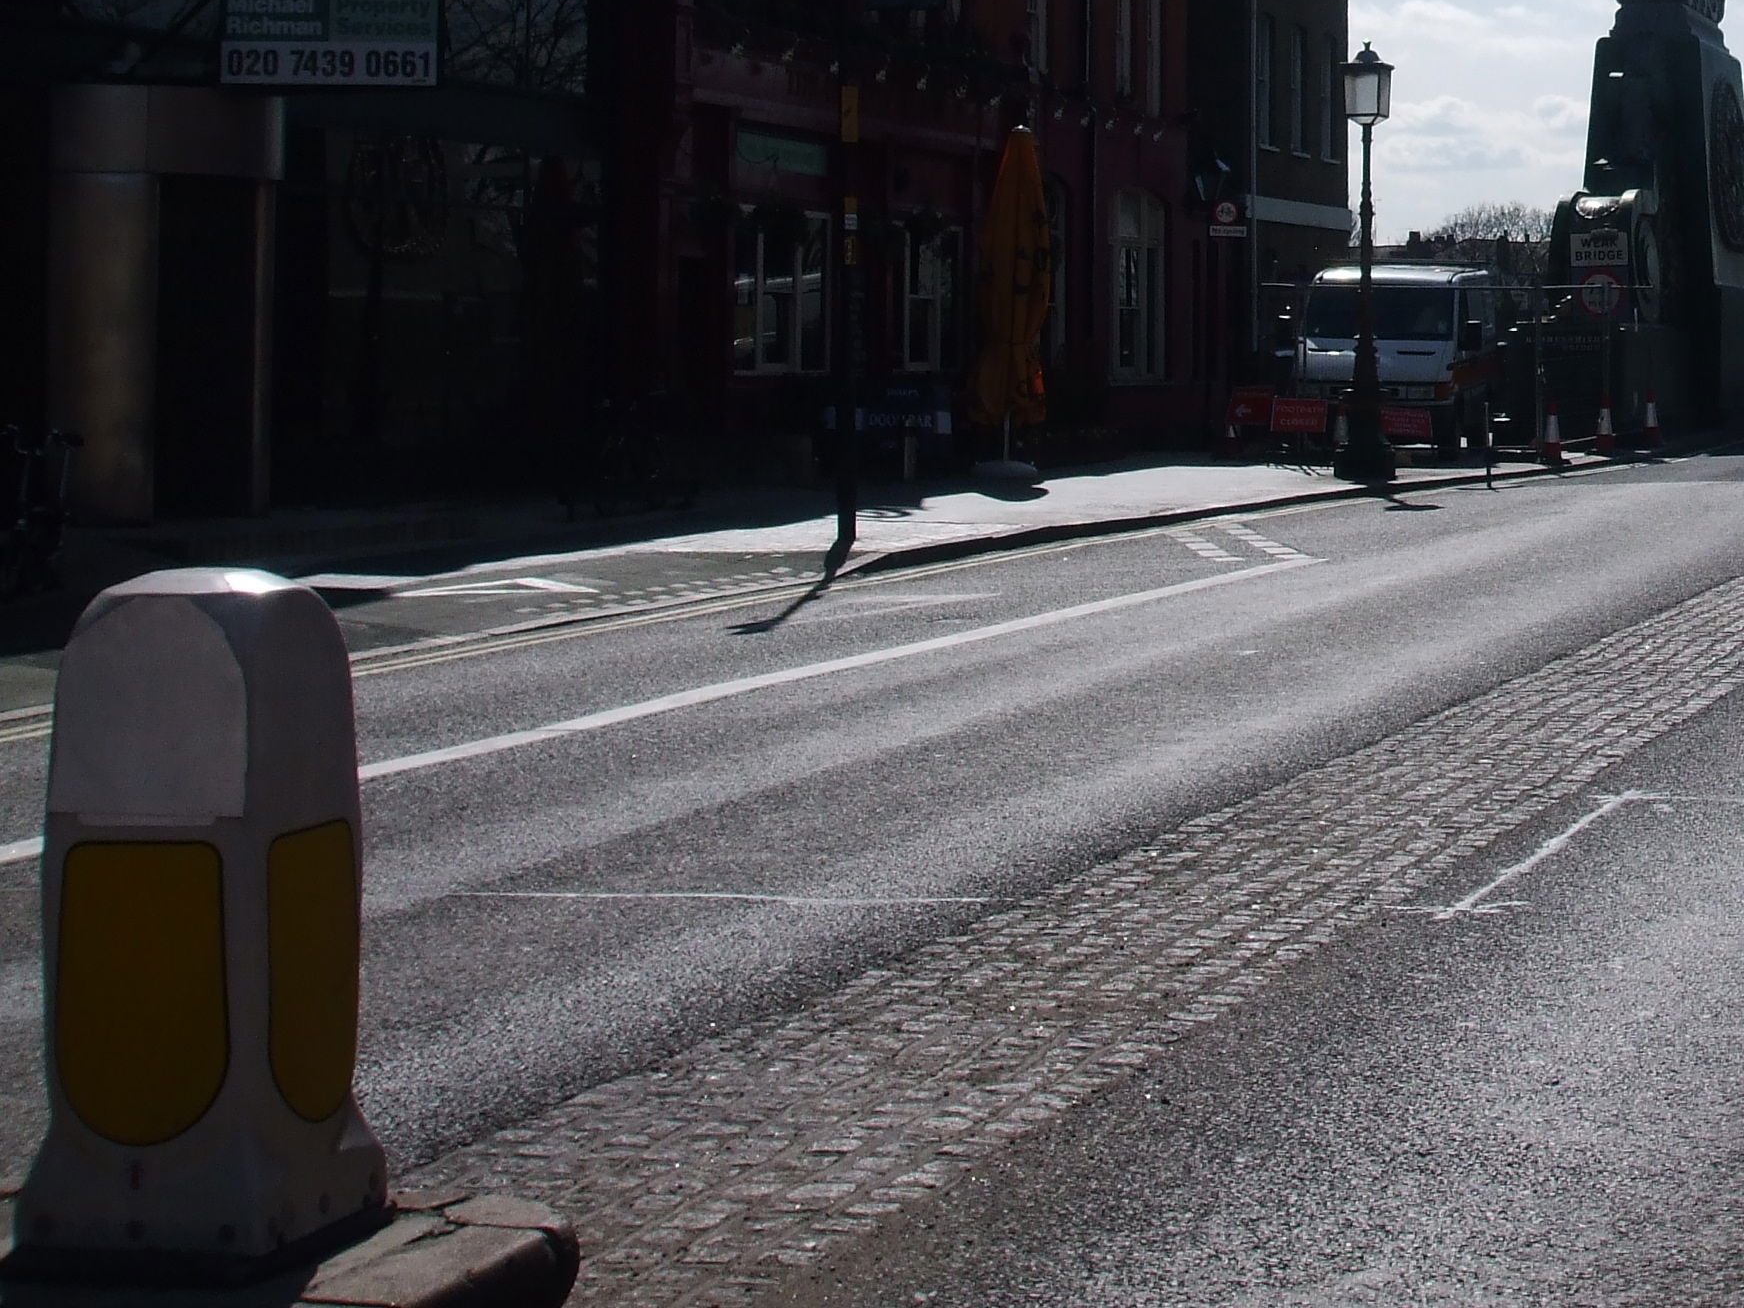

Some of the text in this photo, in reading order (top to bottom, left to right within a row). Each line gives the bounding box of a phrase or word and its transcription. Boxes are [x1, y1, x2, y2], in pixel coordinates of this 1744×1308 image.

[228, 15, 322, 35] Richman
[336, 17, 431, 36] Services
[228, 49, 431, 78] 020 7439 0661
[1581, 235, 1618, 248] WEAK
[1575, 250, 1623, 261] BRIDGE
[1280, 418, 1318, 426] CLOSED
